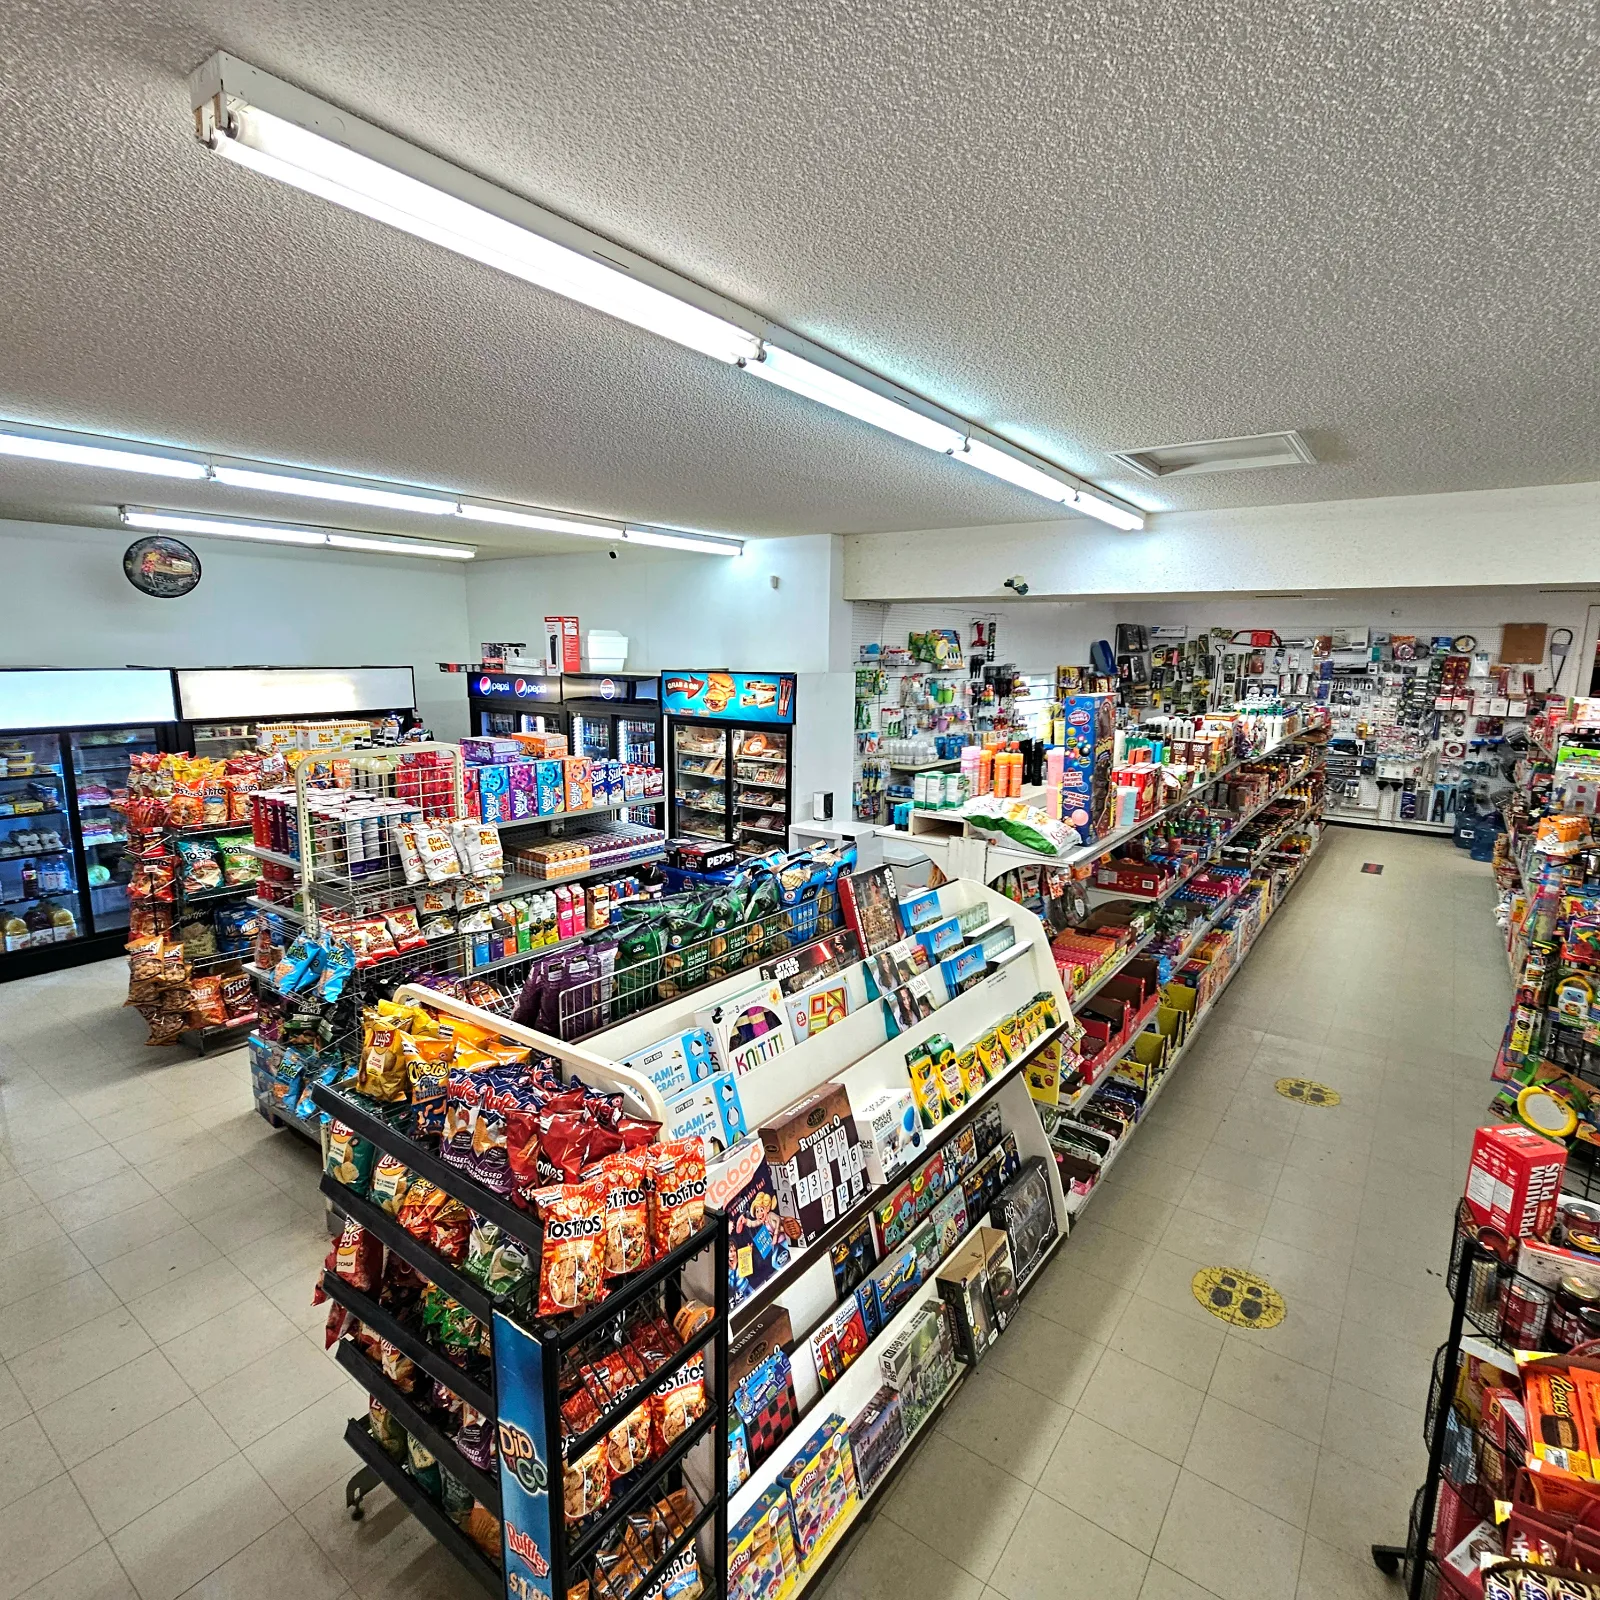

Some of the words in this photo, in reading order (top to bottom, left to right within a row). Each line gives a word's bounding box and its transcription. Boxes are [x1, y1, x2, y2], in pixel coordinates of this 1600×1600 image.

[491, 682, 510, 692] pepsi
[527, 684, 547, 695] pepsi
[667, 682, 684, 690] GRAB
[590, 770, 608, 783] Silk
[430, 842, 451, 852] Dutch
[776, 958, 799, 971] STAR
[774, 966, 800, 980] WARS
[190, 987, 213, 1001] Sun
[735, 1005, 740, 1014] 3
[373, 1030, 391, 1048] Lay's
[872, 1109, 892, 1127] POPULAR
[874, 1115, 893, 1132] SCIENCE
[332, 1120, 354, 1136] Lay
[799, 1114, 840, 1152] RUMMY-O
[838, 1130, 844, 1140] 10
[816, 1143, 822, 1154] 8
[828, 1136, 834, 1148] 9
[378, 1153, 403, 1168] Lay
[842, 1156, 847, 1168] 4
[850, 1148, 857, 1162] 6
[474, 1166, 502, 1180] DRESSED
[536, 1161, 564, 1182] oritos
[780, 1166, 788, 1178] 10
[788, 1160, 795, 1172] 5
[707, 1144, 762, 1204] Taboo
[812, 1174, 818, 1186] 3
[822, 1168, 828, 1180] 3
[800, 1182, 805, 1194] 3
[838, 1186, 846, 1200] 12
[606, 1186, 645, 1209] STITOS
[782, 1192, 788, 1204] 4
[824, 1194, 832, 1208] 12
[1520, 1165, 1546, 1238] PREMIUM
[1540, 1162, 1560, 1202] PLUS
[730, 1323, 764, 1354] RUMMY-O
[500, 1426, 532, 1459] Dip
[516, 1457, 548, 1489] GO
[507, 1522, 550, 1574] Ruffles
